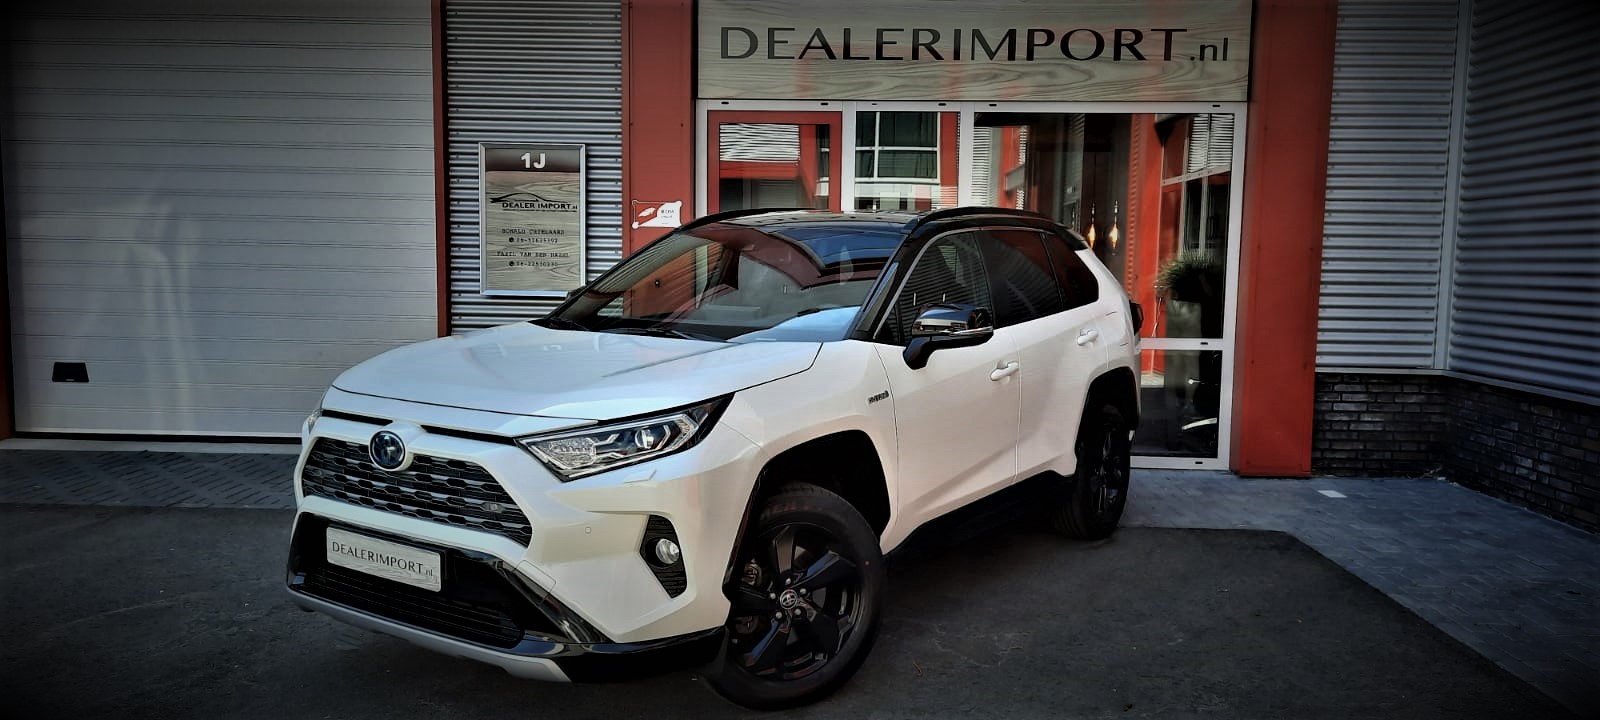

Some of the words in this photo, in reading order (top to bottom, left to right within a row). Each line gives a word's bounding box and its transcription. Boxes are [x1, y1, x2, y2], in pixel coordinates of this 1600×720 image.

[720, 26, 1229, 62] DEALERIMPORT.nl
[521, 152, 546, 169] 1J
[332, 541, 433, 577] DEALERIMPORTnl
